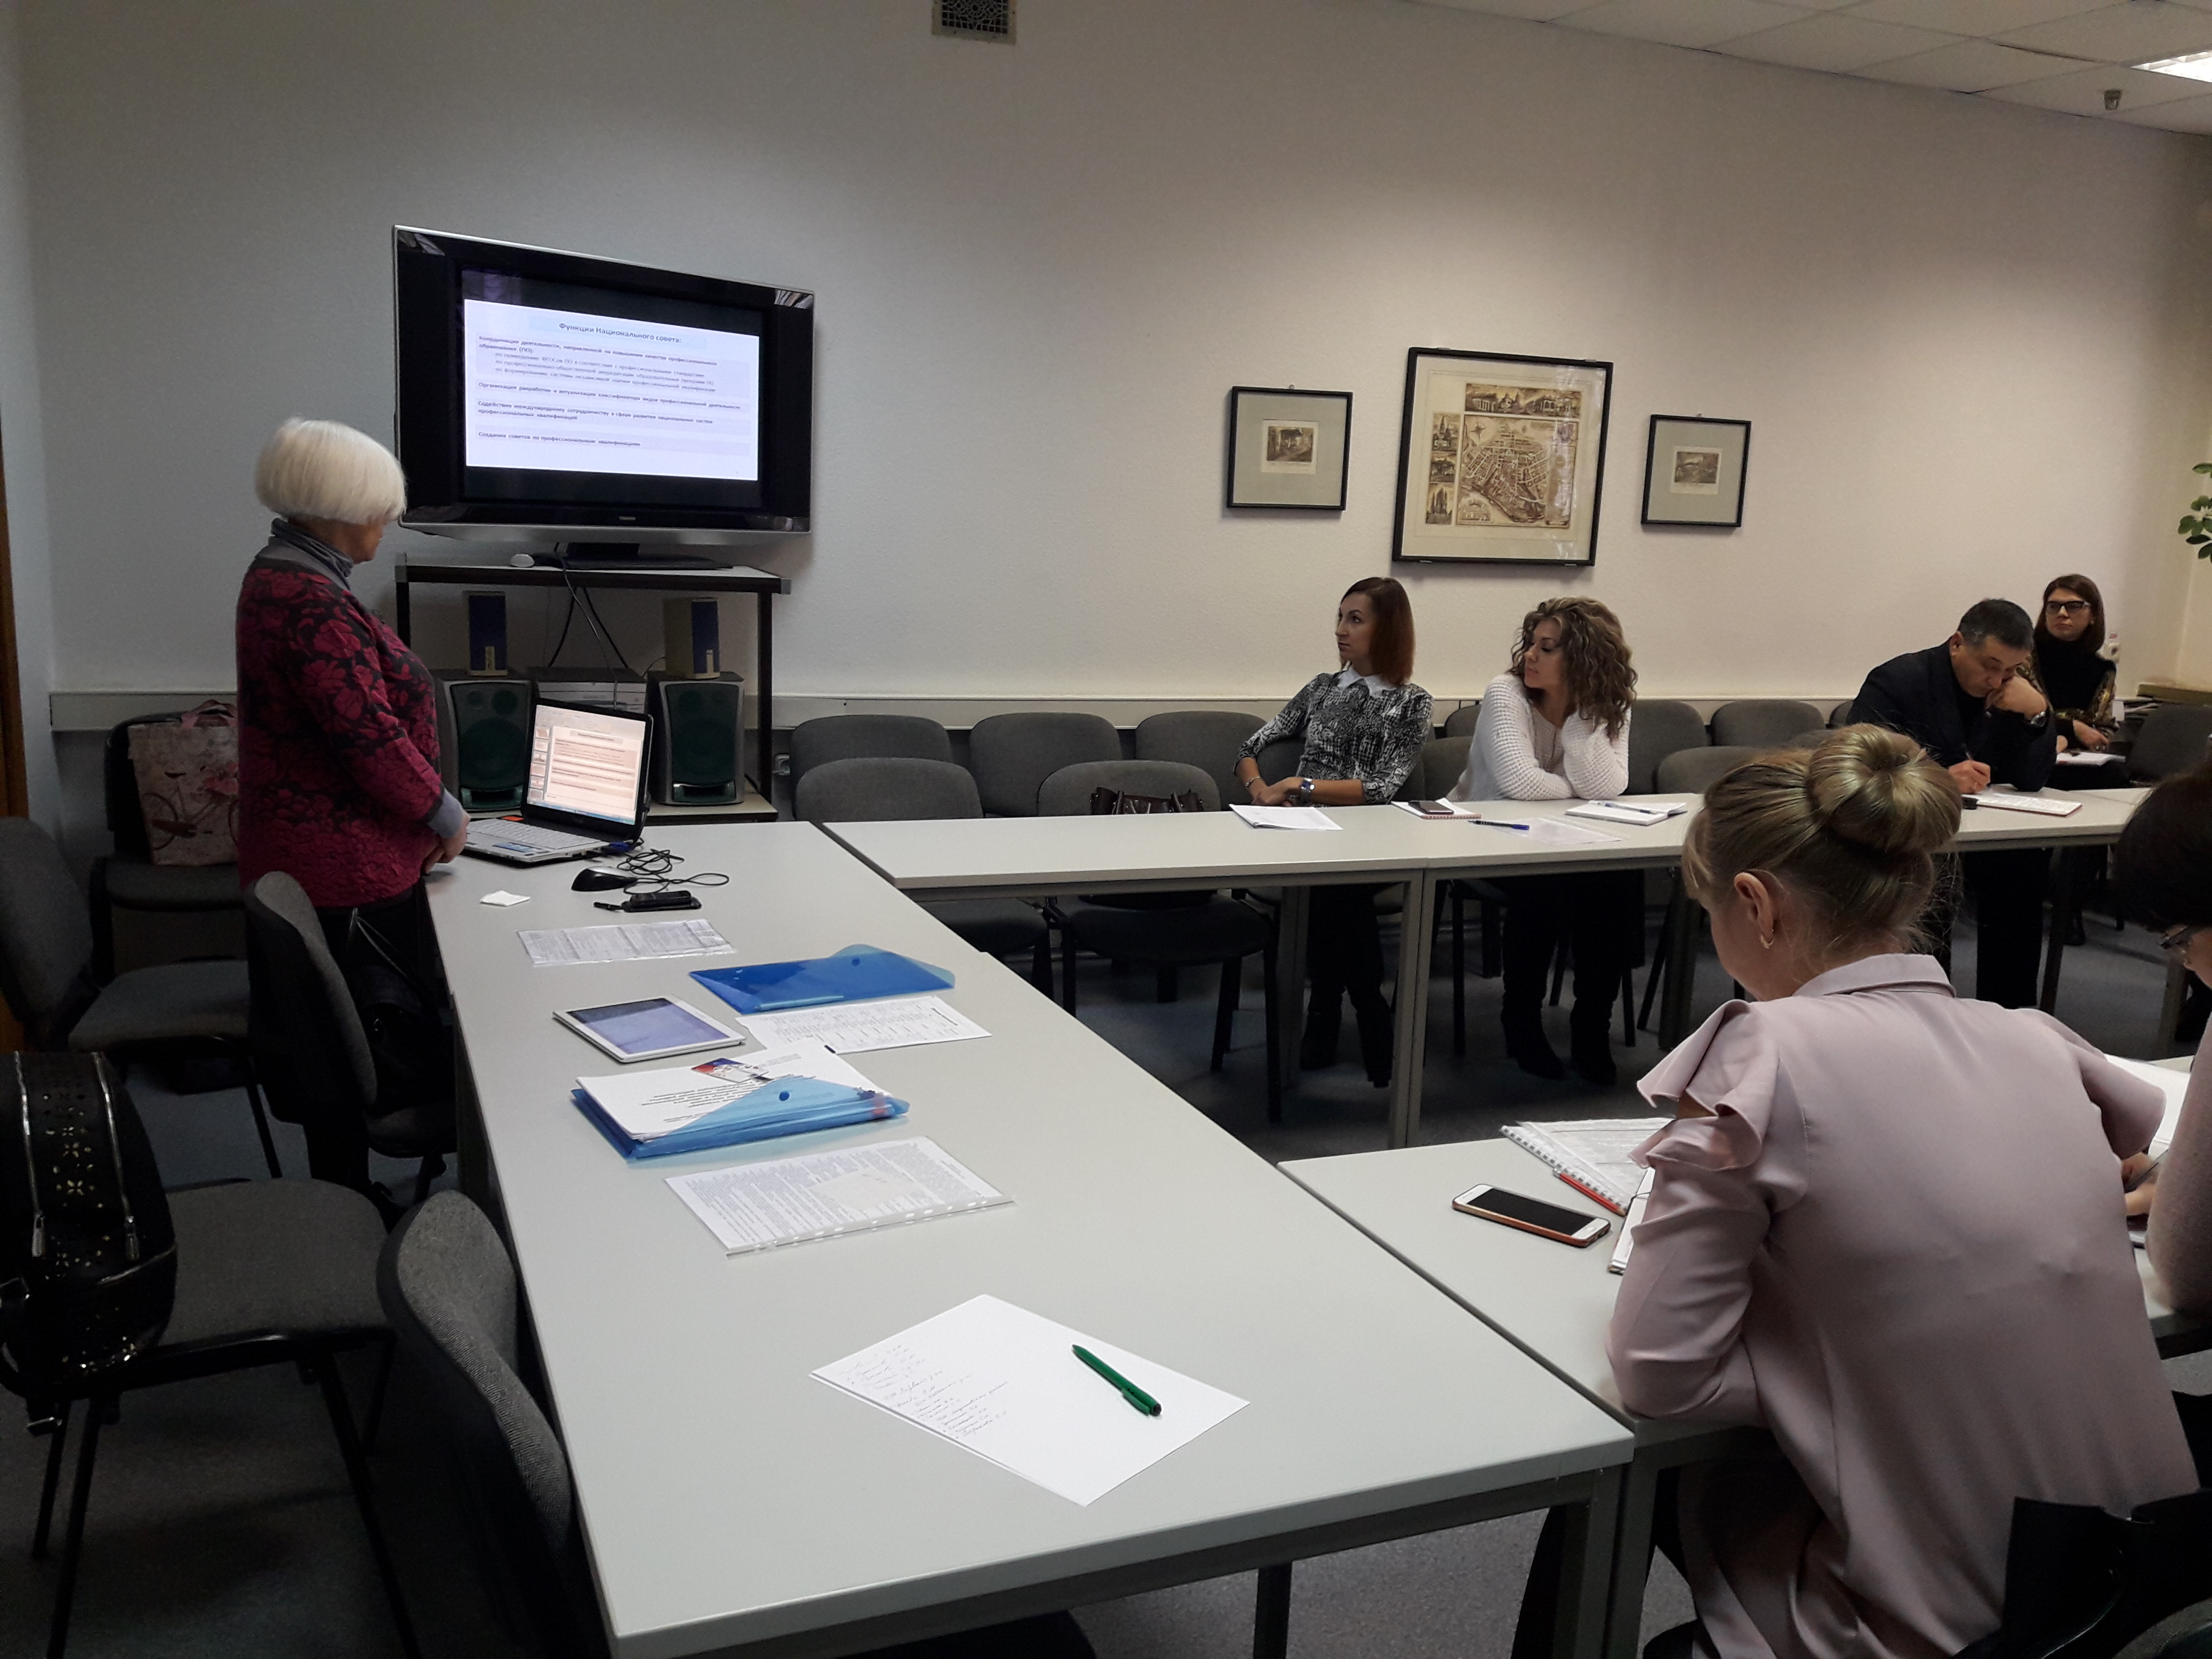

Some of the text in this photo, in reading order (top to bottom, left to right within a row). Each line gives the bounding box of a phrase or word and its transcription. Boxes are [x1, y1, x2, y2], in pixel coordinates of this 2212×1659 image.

[559, 323, 682, 343] Функции Национального совета:
